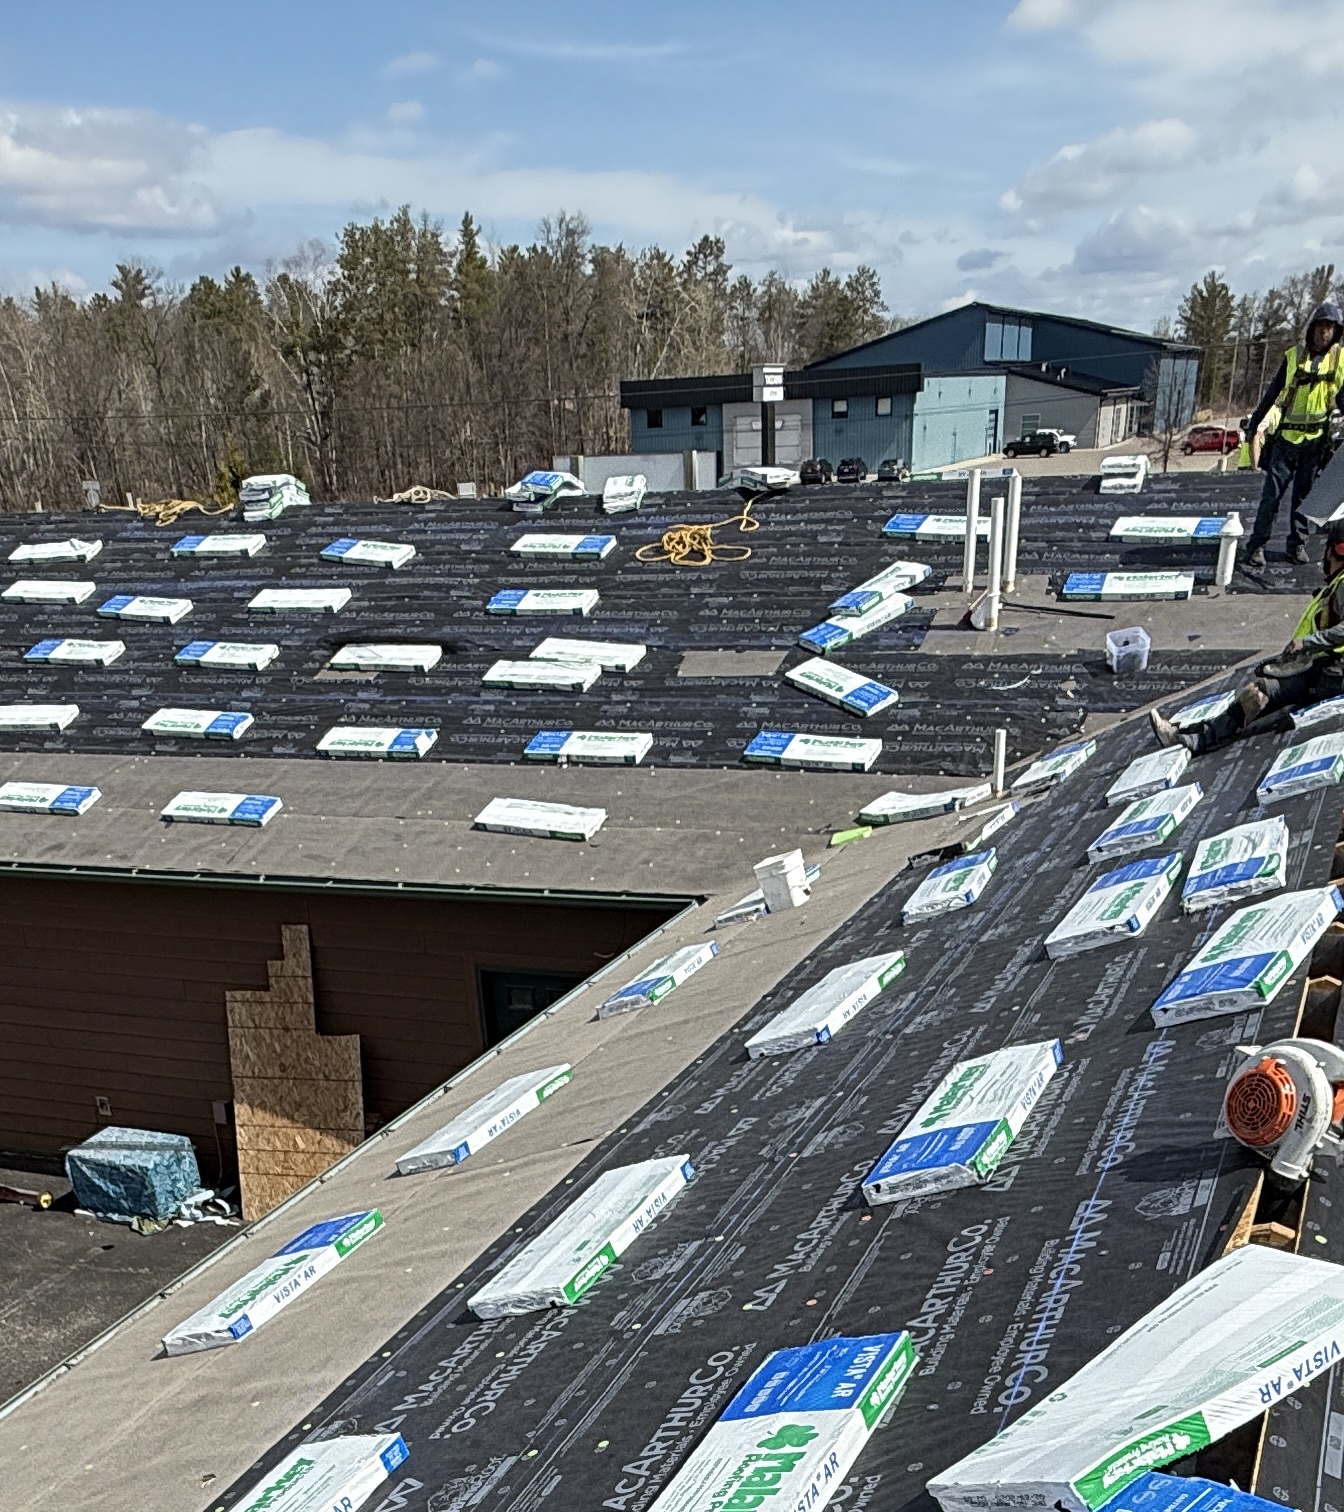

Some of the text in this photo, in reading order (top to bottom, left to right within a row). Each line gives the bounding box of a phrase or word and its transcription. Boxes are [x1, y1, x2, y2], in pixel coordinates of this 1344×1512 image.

[1293, 1091, 1312, 1131] STIHL
[1259, 1379, 1285, 1406] AR
[712, 1453, 758, 1499] Roofing
[821, 1451, 840, 1482] AR
